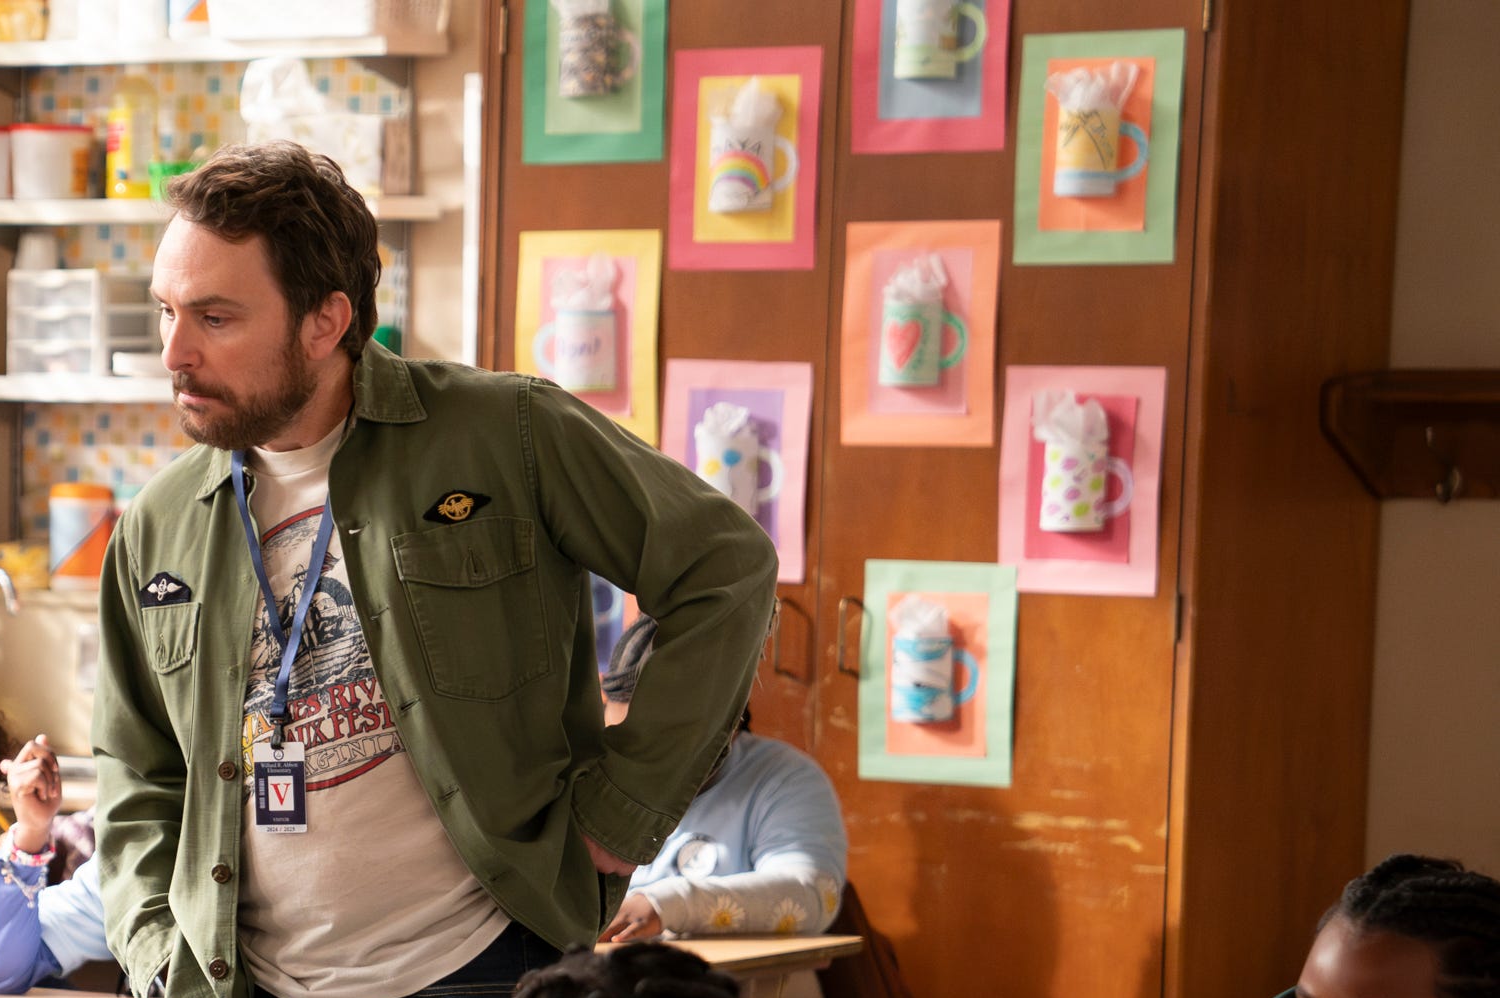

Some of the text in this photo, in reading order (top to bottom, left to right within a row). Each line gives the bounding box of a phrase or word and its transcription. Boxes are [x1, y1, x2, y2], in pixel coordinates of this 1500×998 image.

[242, 693, 321, 748] JAES
[328, 702, 397, 740] FEST
[270, 783, 291, 806] V
